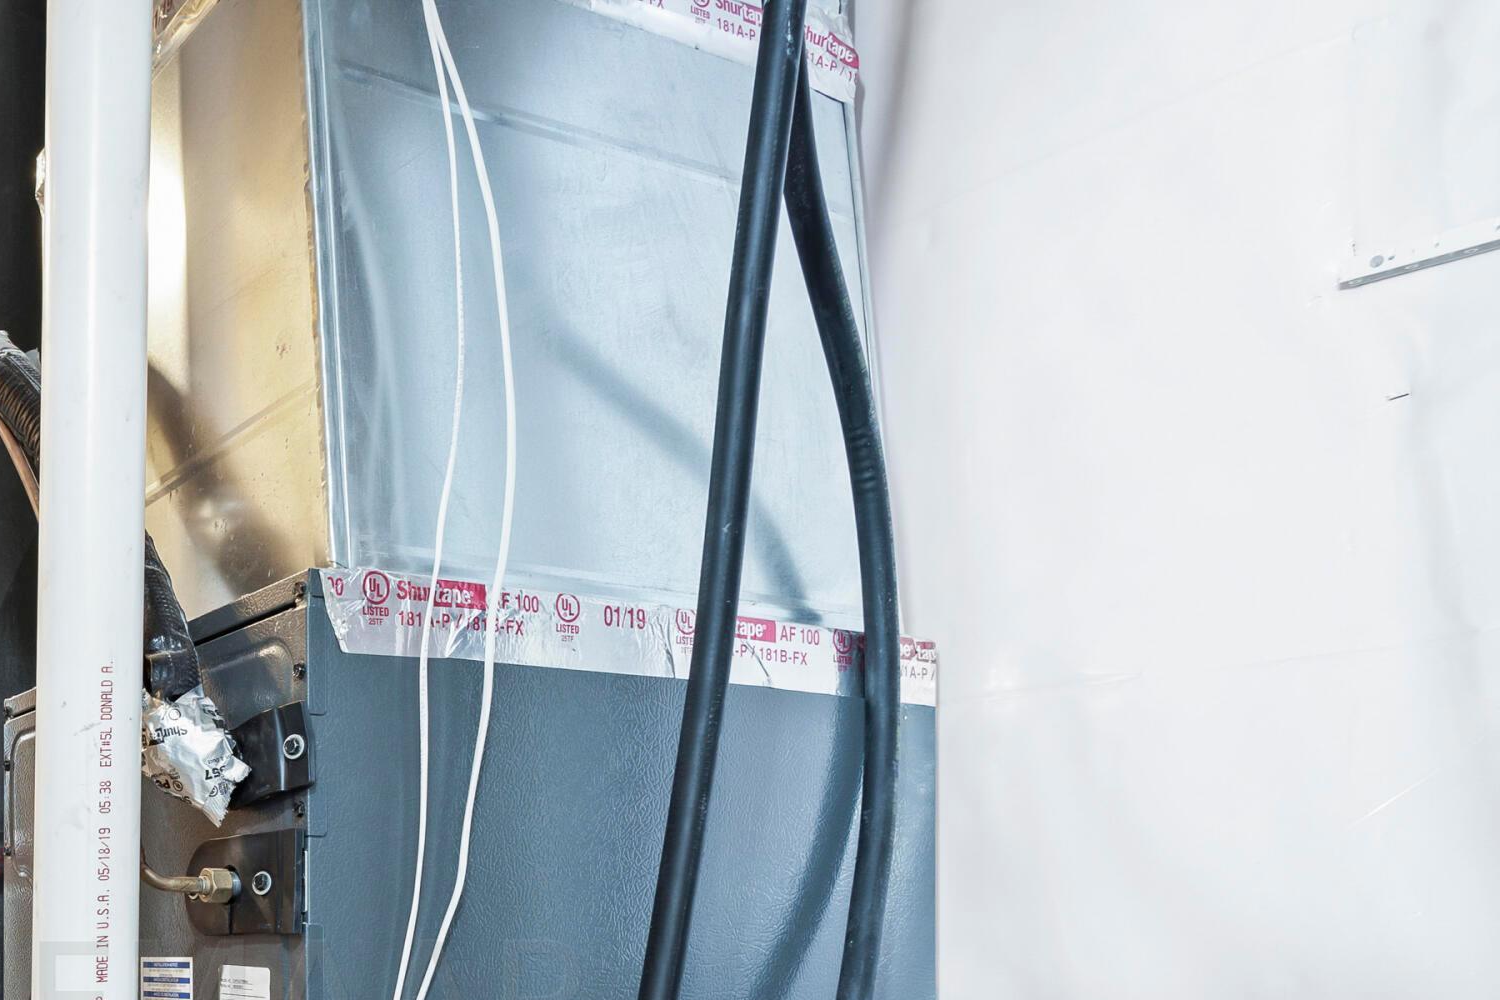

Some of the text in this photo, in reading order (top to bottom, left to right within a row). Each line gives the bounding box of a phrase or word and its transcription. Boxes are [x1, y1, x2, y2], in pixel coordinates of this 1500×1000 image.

[717, 17, 757, 41] 181A-P
[803, 25, 858, 65] hurtape
[362, 605, 390, 618] LISTED
[515, 595, 540, 613] 100
[555, 623, 580, 635] LISTED
[603, 605, 646, 630] 01/19
[675, 635, 695, 647] LISTE
[780, 624, 821, 646] AF 100
[101, 661, 114, 674] A.
[759, 646, 808, 666] 181B-FX
[100, 680, 113, 721] DONALD
[99, 780, 112, 815] 05:38
[98, 828, 111, 882] 05/18/19
[97, 889, 110, 930] U.S.A.
[96, 935, 109, 949] IN
[96, 956, 108, 983] MADE
